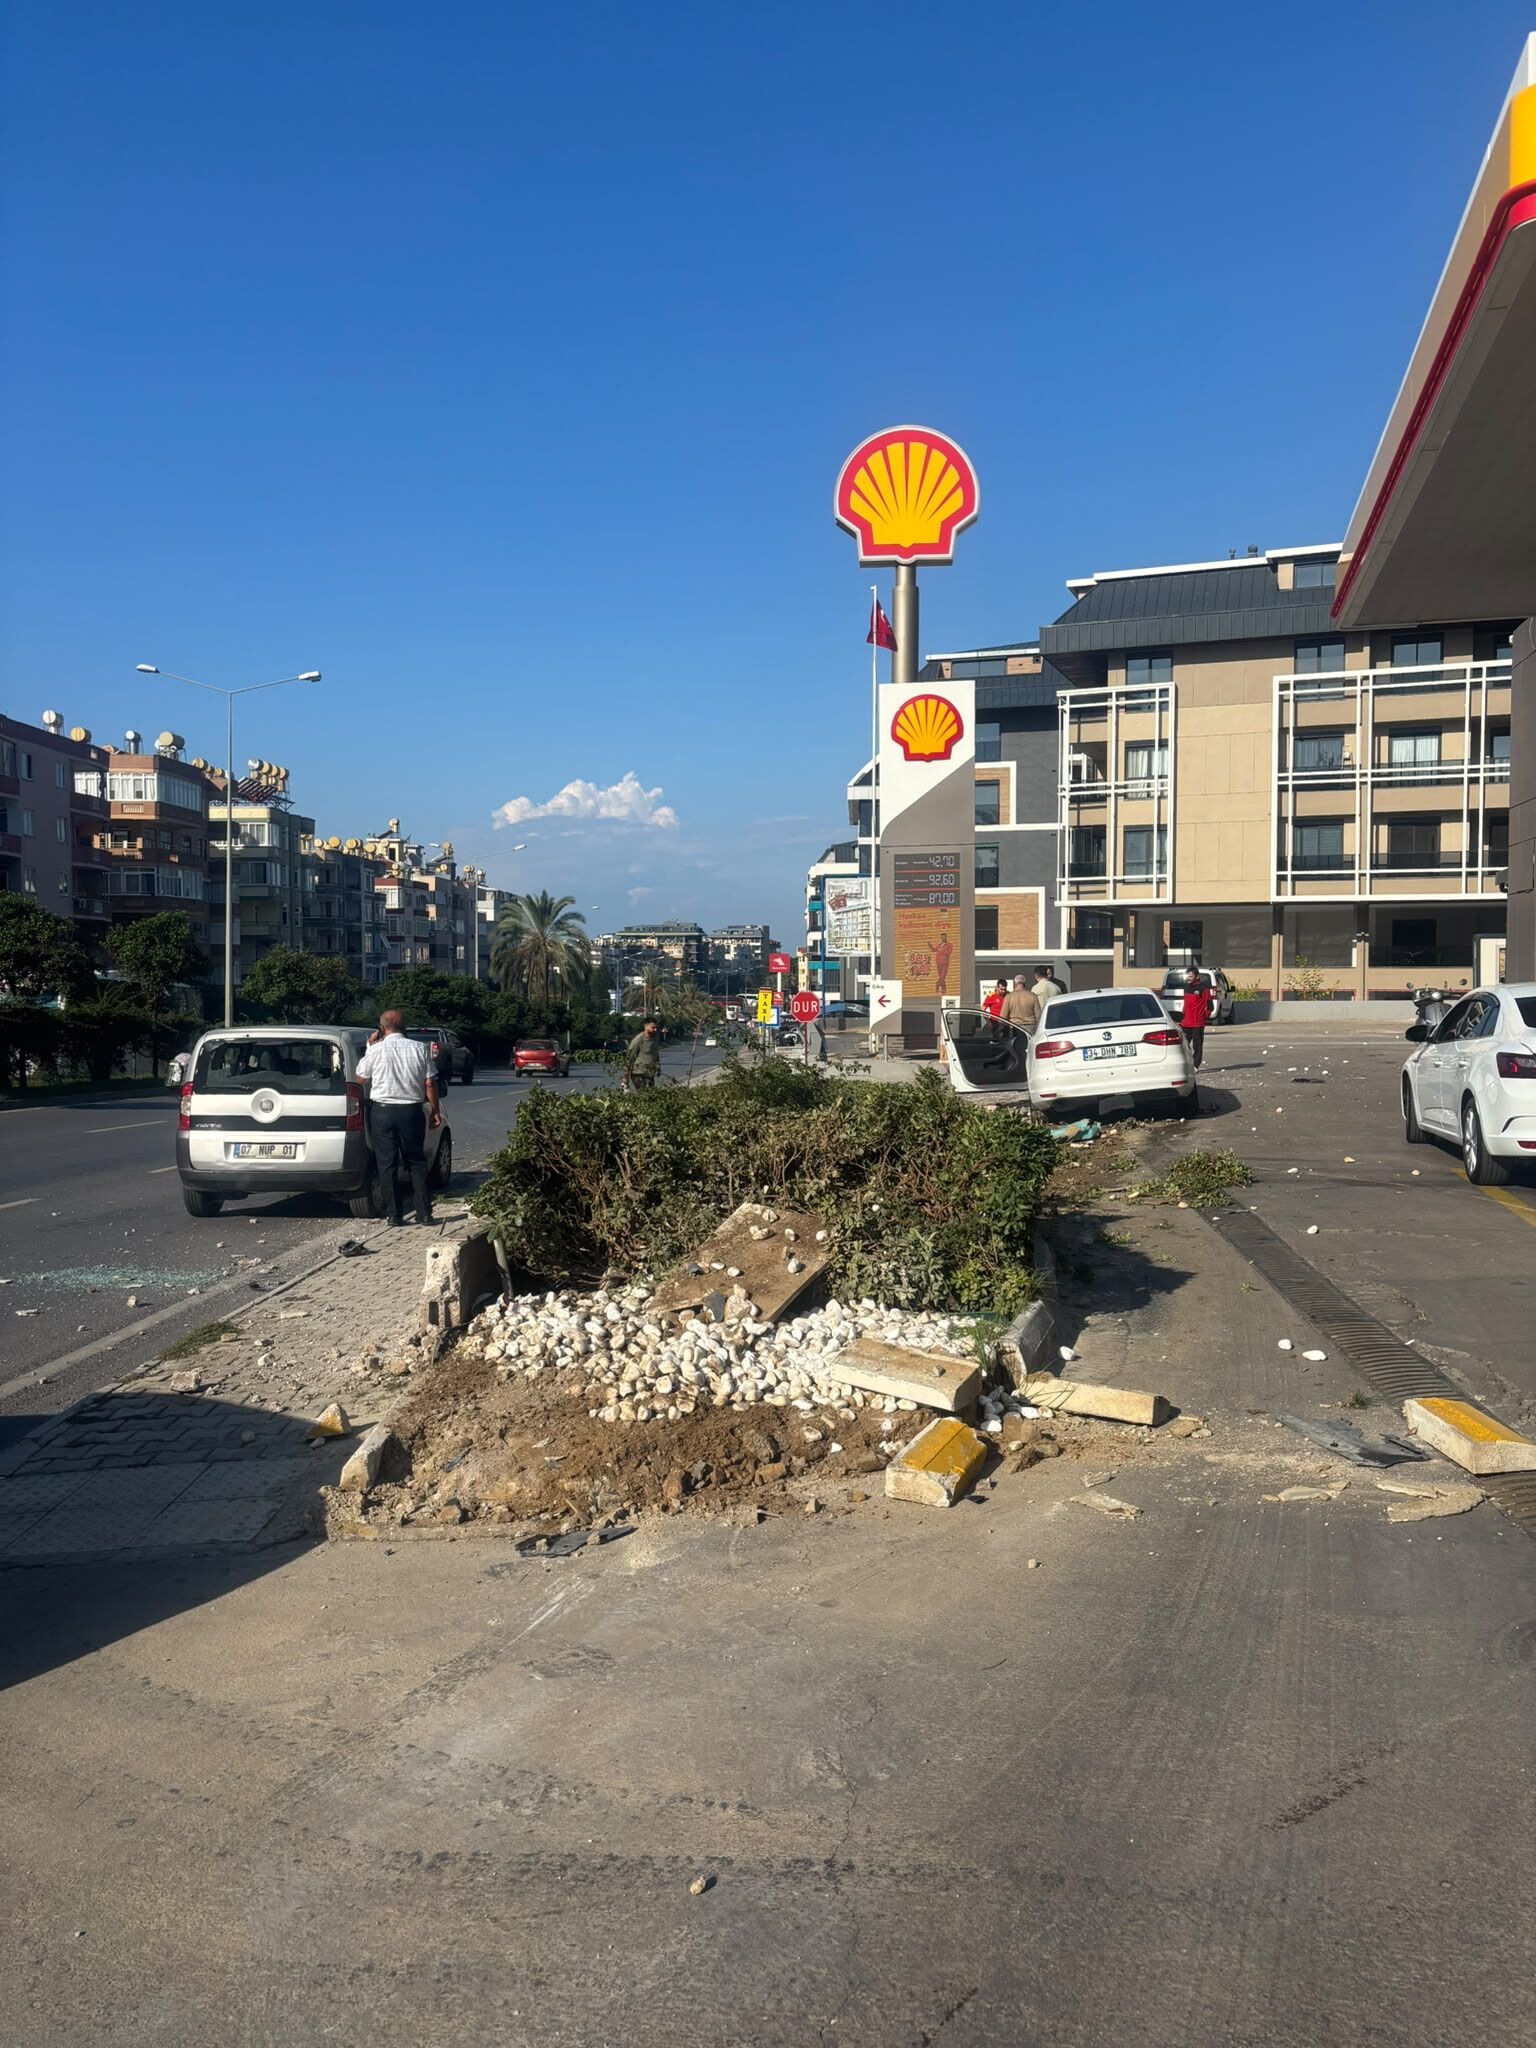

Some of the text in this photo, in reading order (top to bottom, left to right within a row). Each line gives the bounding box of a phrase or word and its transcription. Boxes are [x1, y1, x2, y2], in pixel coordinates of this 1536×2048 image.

[929, 874, 955, 886] 92,60
[929, 893, 955, 904] 87,00
[793, 1001, 818, 1013] DUR
[1088, 1048, 1098, 1058] 34
[1119, 1044, 1134, 1054] 789
[240, 1145, 293, 1155] 07 NUP 01
